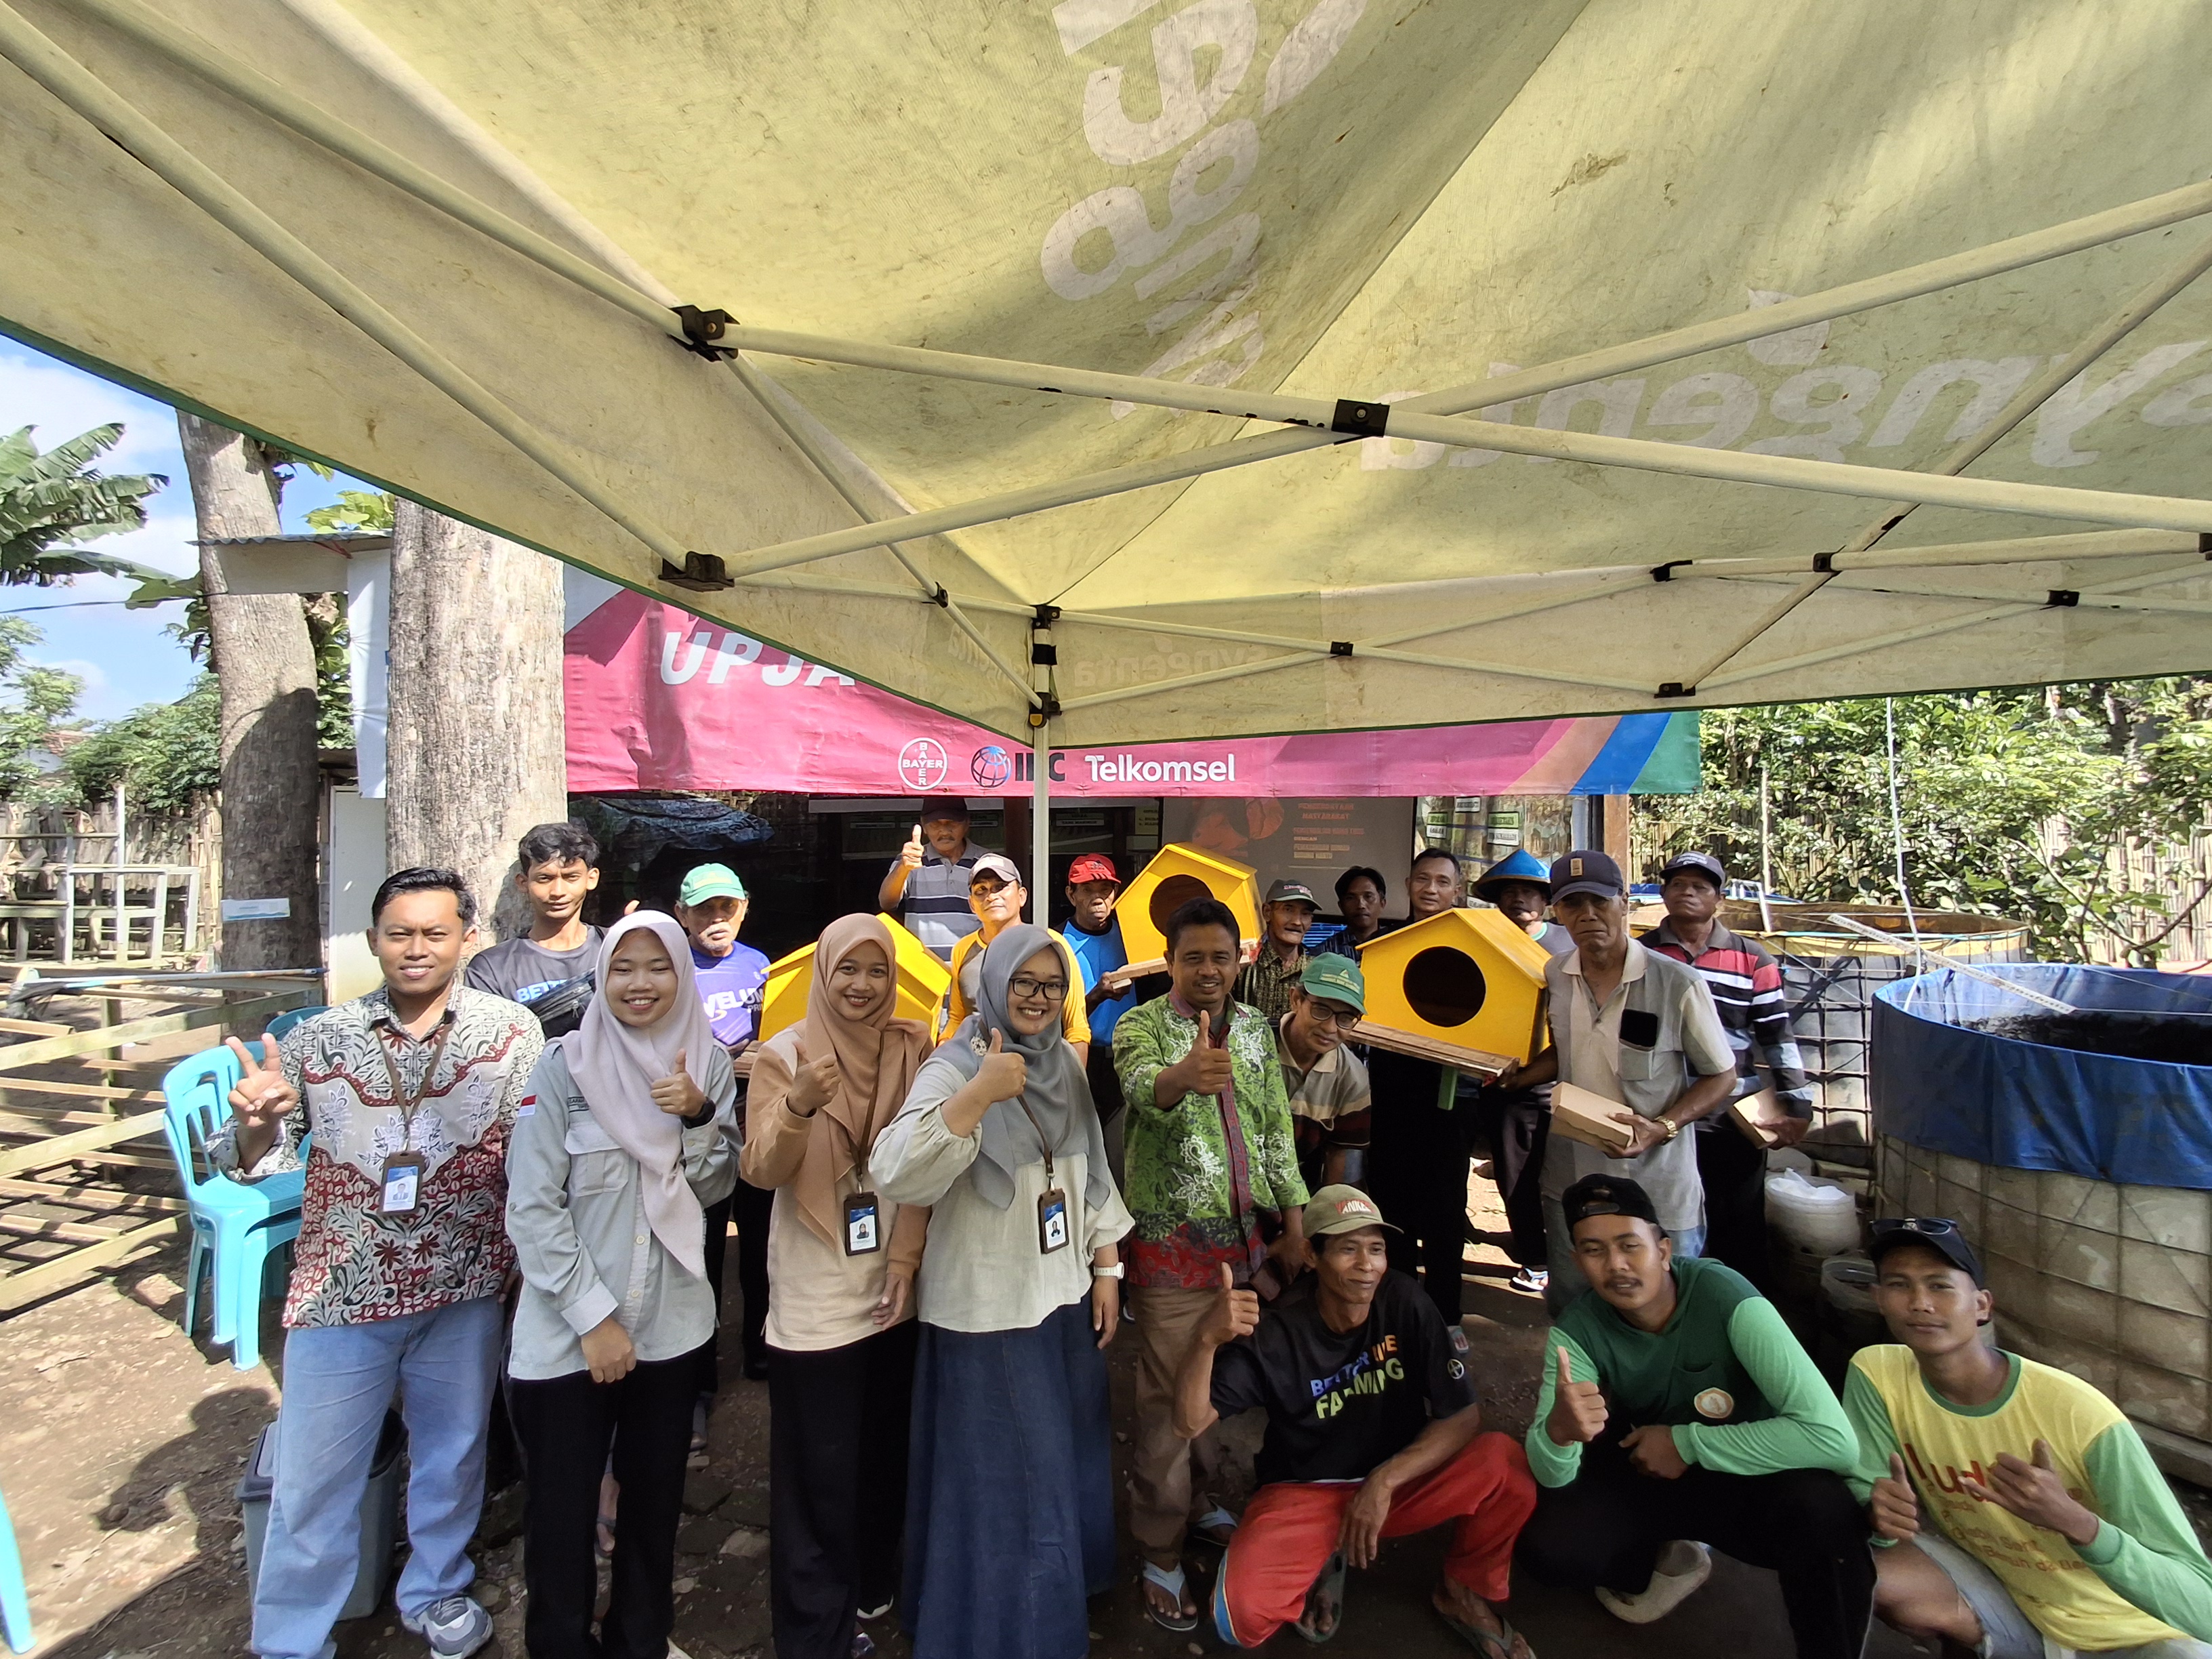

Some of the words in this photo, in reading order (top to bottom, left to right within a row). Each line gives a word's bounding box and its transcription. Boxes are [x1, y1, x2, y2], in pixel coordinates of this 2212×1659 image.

[903, 759, 943, 769] BAYER
[918, 742, 927, 786] BAYER
[1015, 753, 1065, 781] IC
[1084, 754, 1235, 782] Telkomsel
